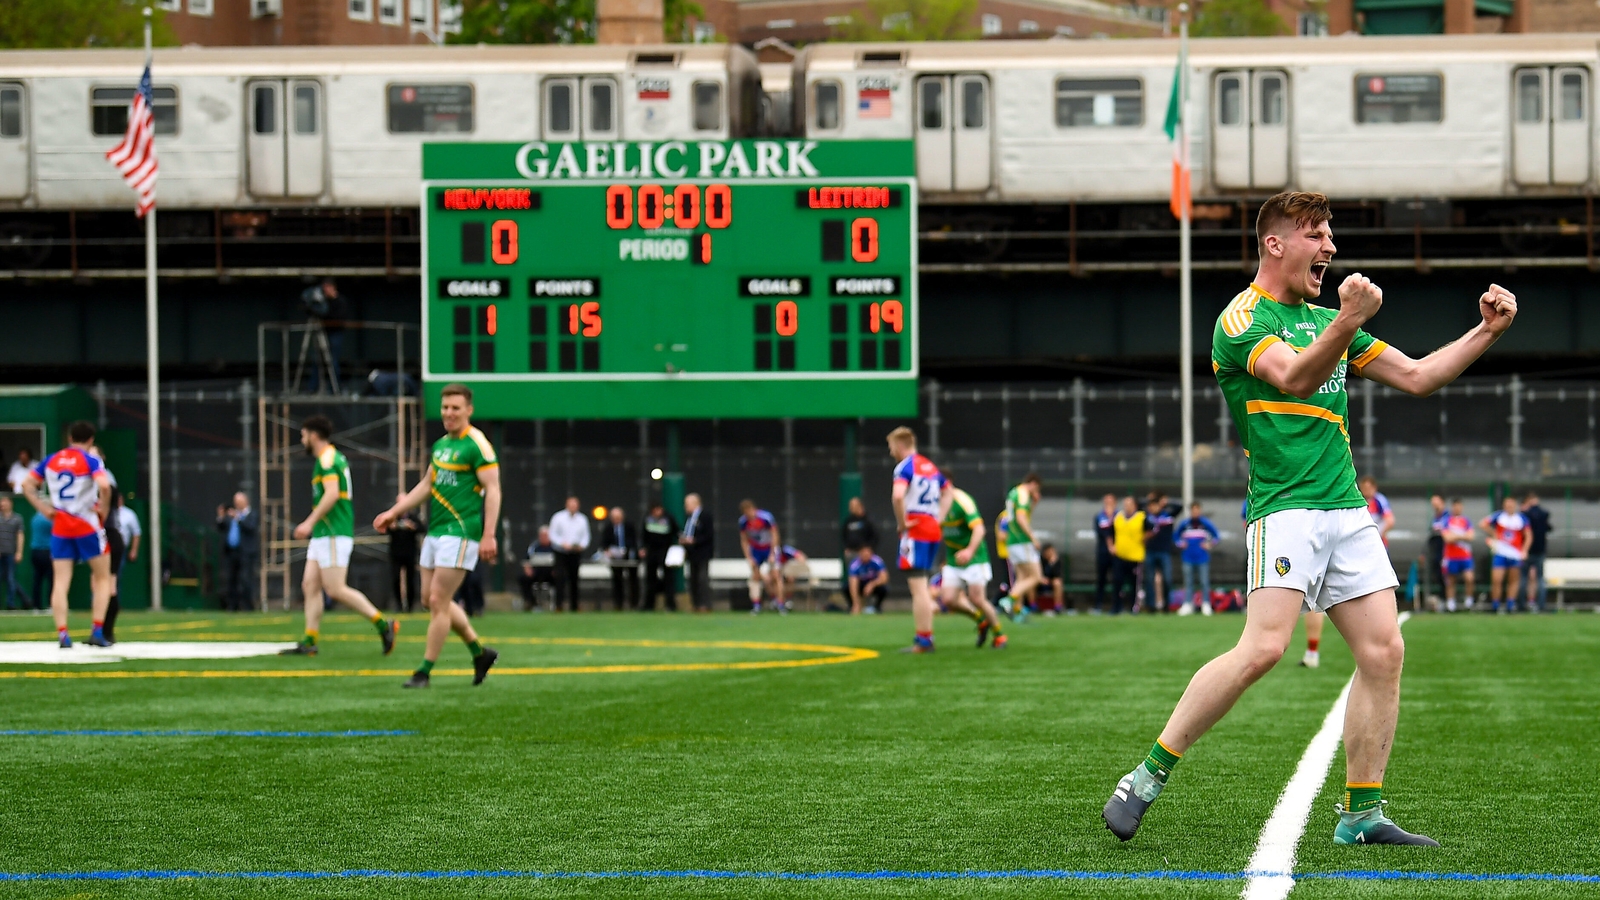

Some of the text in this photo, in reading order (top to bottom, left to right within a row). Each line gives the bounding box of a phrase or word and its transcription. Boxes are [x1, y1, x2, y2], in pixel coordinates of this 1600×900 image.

[515, 140, 820, 179] GAELIC PARK
[606, 184, 732, 229] 00:00
[809, 186, 889, 208] LEITRIM
[492, 219, 518, 264] 0
[619, 232, 712, 264] PERIOD 1
[852, 217, 879, 262] 0
[447, 280, 501, 296] GOALS
[535, 279, 594, 296] POINTS
[748, 278, 802, 295] GOALS
[835, 278, 895, 294] POINTS
[486, 304, 497, 336] 1
[569, 301, 602, 337] 15
[775, 300, 798, 337] 0
[869, 300, 903, 334] 19
[57, 471, 75, 499] 2
